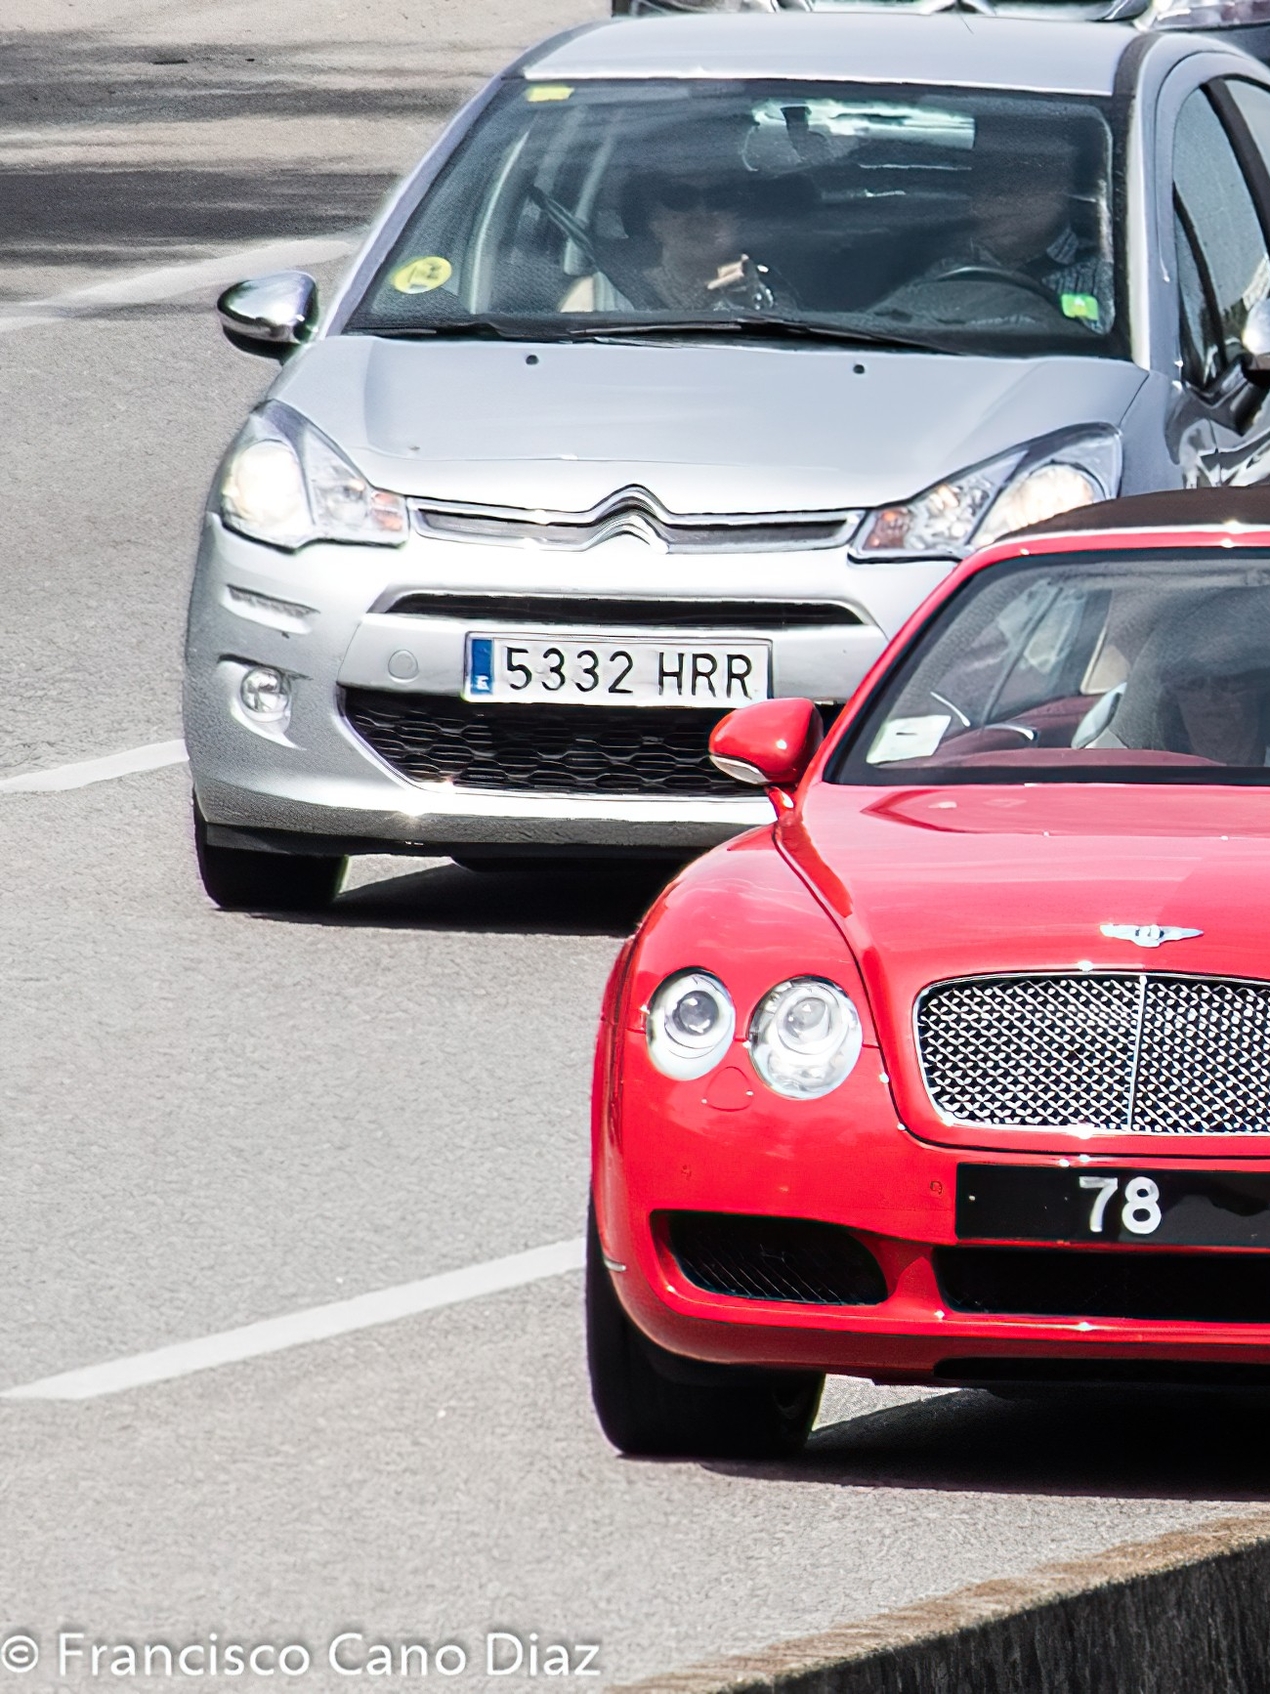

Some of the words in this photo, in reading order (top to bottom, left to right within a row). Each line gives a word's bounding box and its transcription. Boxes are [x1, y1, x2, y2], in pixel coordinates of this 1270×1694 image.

[505, 646, 634, 694] 5332
[658, 651, 753, 699] HRR
[1078, 1176, 1162, 1235] 78
